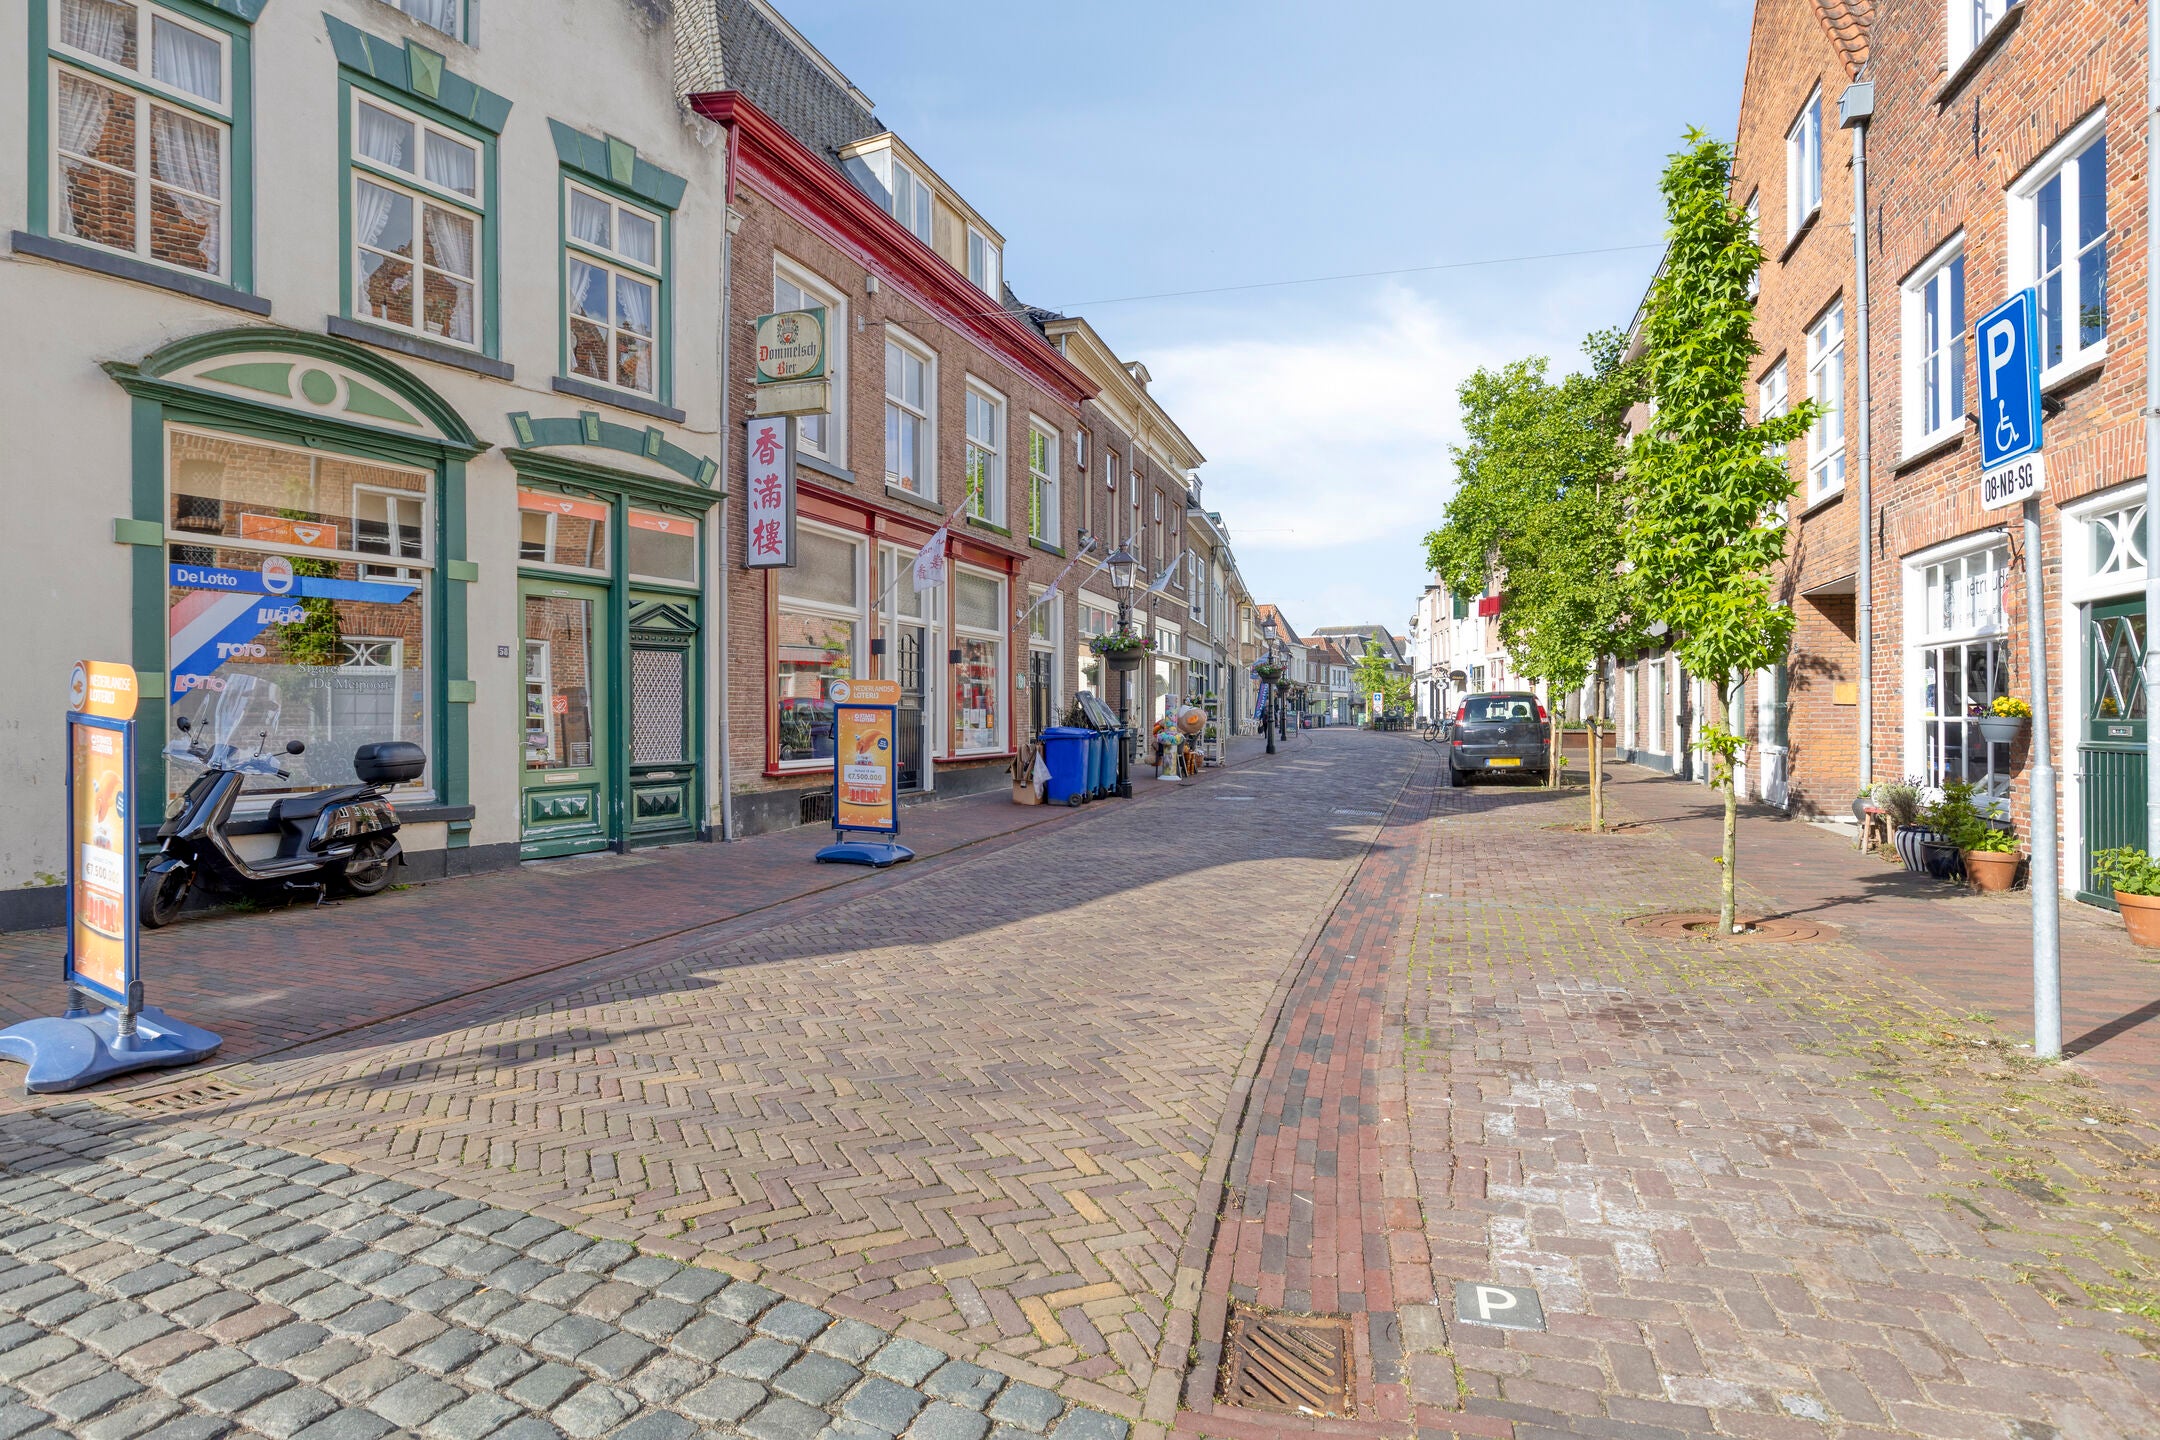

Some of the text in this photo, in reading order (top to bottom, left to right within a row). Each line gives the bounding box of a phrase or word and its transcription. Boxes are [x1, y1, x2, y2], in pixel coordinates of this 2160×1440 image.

[759, 341, 816, 362] Dommelsch
[1986, 318, 2016, 400] P
[777, 360, 797, 375] Bier
[1985, 462, 2033, 502] 08-NB-SG
[176, 569, 238, 586] De Lotto
[216, 642, 267, 659] TOTO
[174, 673, 226, 692] LOTTO
[1476, 1286, 1517, 1319] P
